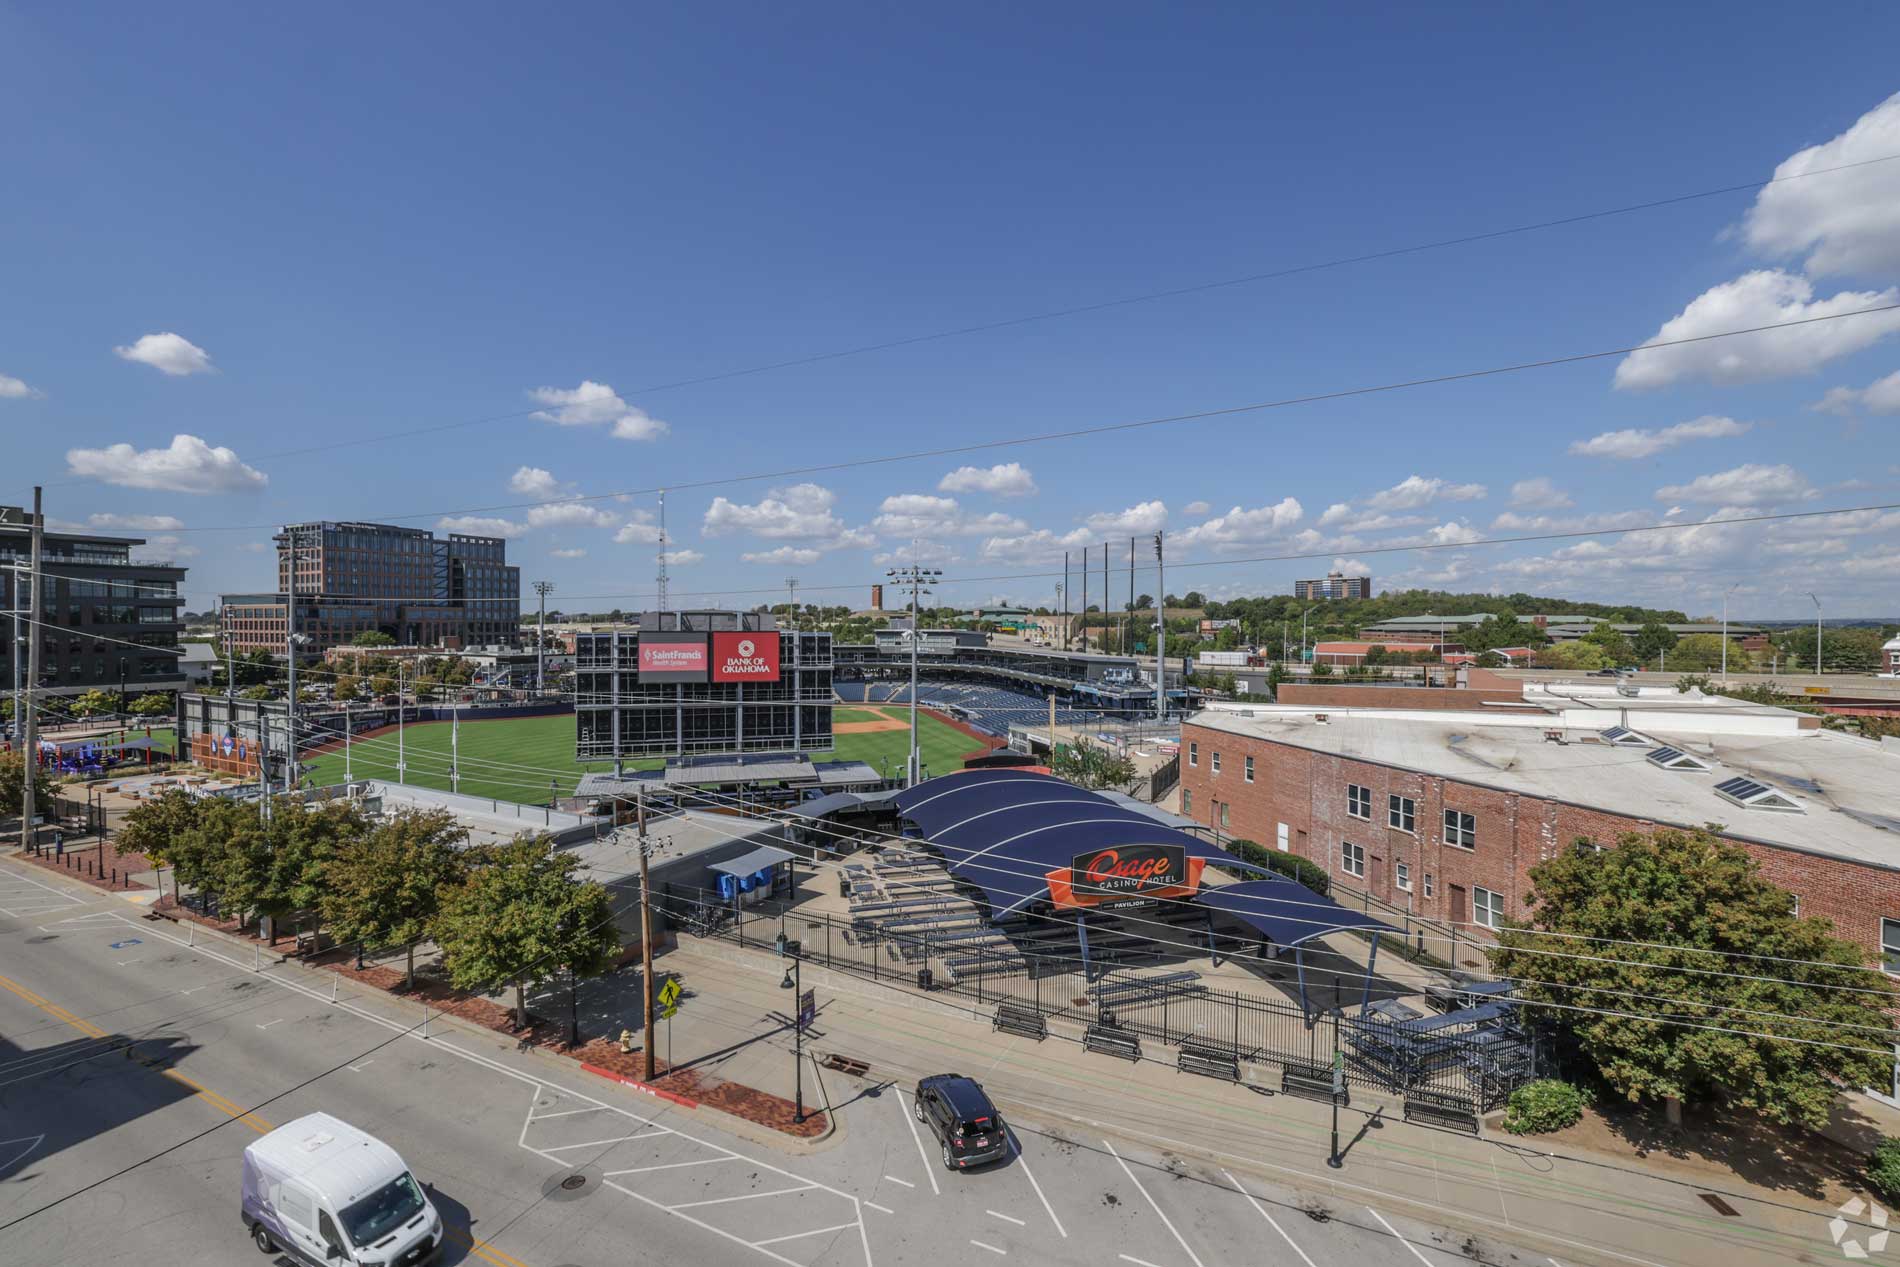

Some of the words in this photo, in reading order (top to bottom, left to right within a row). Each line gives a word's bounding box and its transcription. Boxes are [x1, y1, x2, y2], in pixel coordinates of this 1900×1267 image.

[722, 665, 770, 673] OKLAHOMA
[1085, 849, 1170, 890] Osage
[1099, 879, 1138, 889] CASINO
[1146, 875, 1177, 884] HOTEL
[1114, 900, 1145, 909] PAVILION
